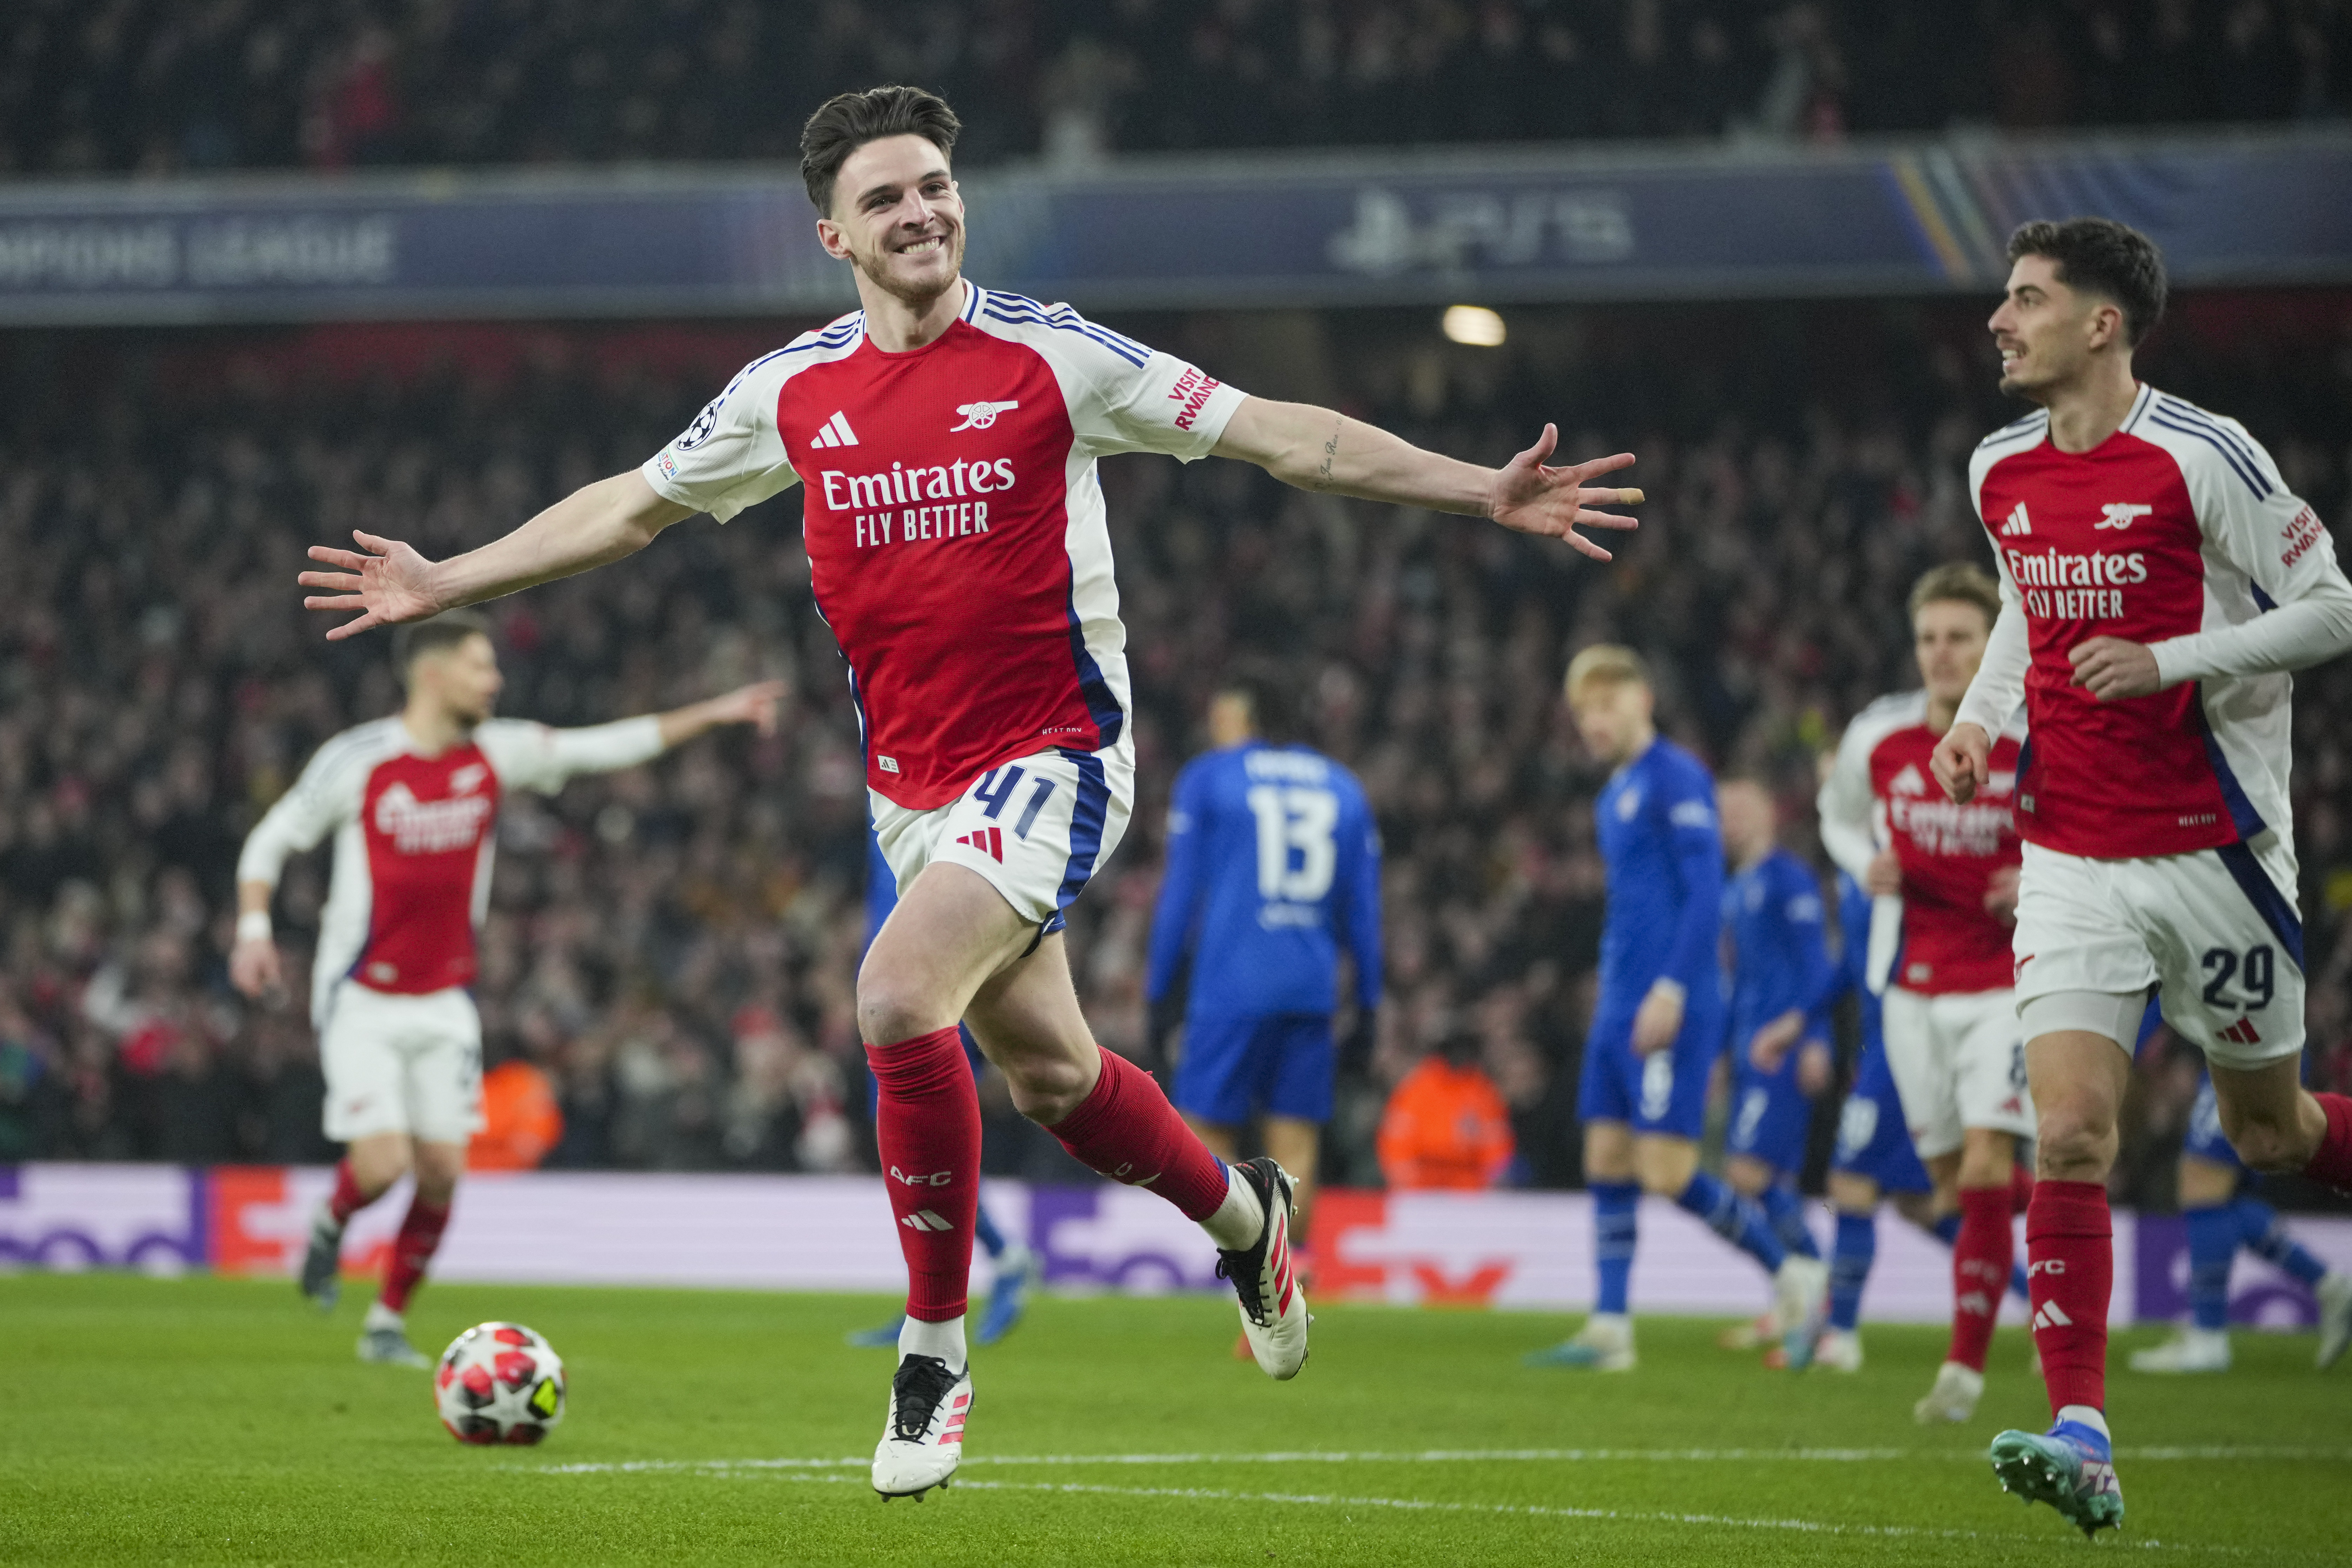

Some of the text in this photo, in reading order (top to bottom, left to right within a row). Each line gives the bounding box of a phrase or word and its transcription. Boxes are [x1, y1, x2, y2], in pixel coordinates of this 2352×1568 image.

[1168, 368, 1201, 400] VISIT
[820, 457, 1015, 510] Emirates
[856, 502, 989, 548] FLY BETTER
[2007, 546, 2147, 587] Emirates
[2054, 589, 2124, 619] BETTER
[972, 764, 1058, 842] 41
[1247, 785, 1340, 904] 13
[2202, 944, 2274, 1011] 29
[890, 1165, 951, 1186] AFC
[2027, 1259, 2065, 1279] FC
